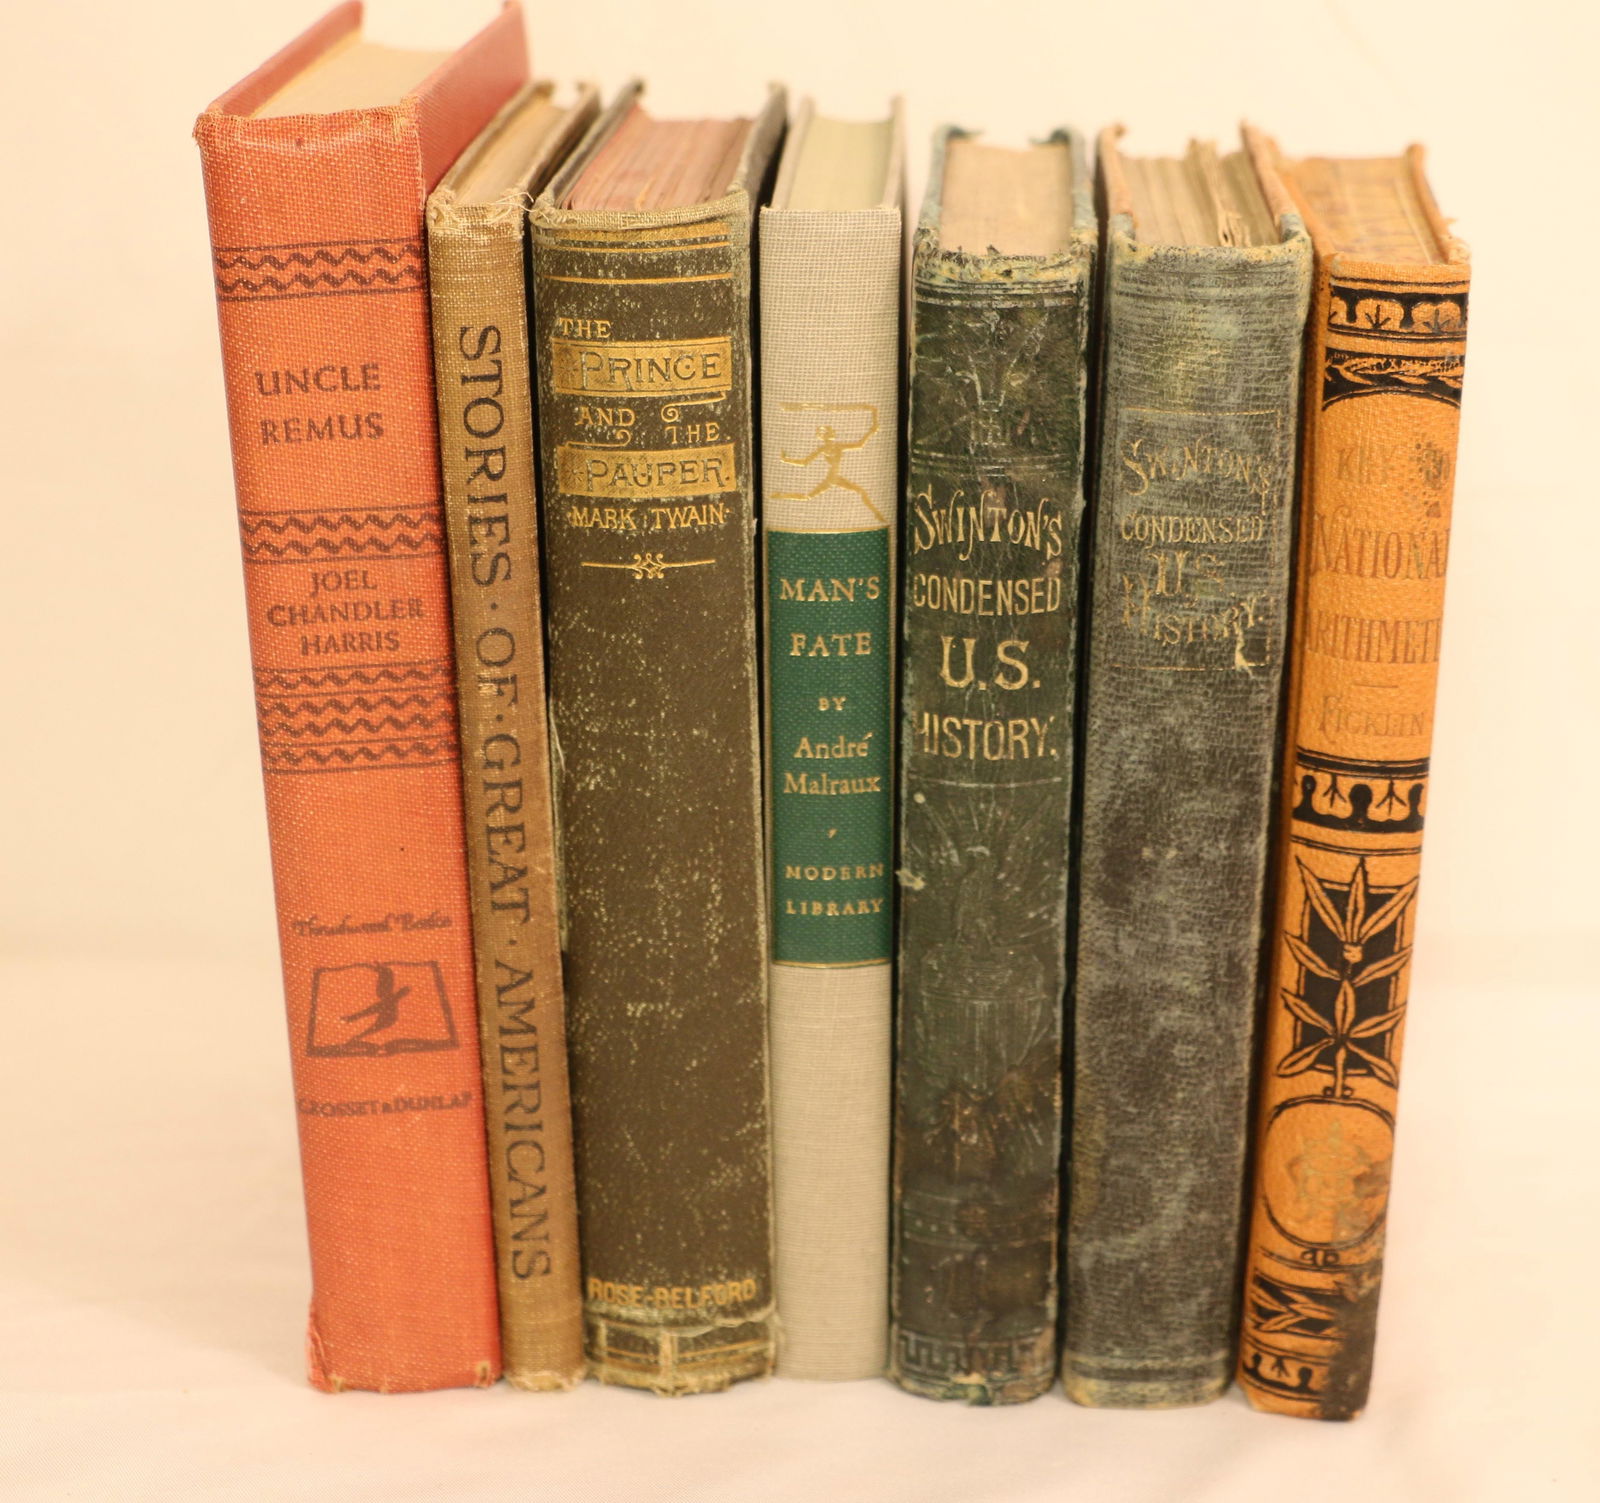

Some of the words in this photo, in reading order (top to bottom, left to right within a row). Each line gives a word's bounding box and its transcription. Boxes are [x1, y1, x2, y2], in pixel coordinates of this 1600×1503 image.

[559, 318, 611, 338] THE
[255, 363, 382, 397] UNCLE
[579, 351, 722, 391] PRINCE
[260, 412, 384, 446] REMUS
[575, 406, 636, 427] AND
[460, 325, 511, 588] STORIES
[572, 506, 637, 530] MARK
[651, 503, 725, 529] TWAIN
[914, 484, 1062, 561] SWINTON'S
[1121, 510, 1264, 550] CONDENSED
[310, 570, 377, 598] JOEL
[780, 576, 881, 602] MAN'S
[913, 573, 1061, 616] CONDENSED
[267, 597, 424, 627] CHANDLER
[301, 631, 401, 657] HARRIS
[790, 632, 872, 657] FATE
[476, 627, 518, 706] OF
[940, 635, 1041, 690] U.S.
[819, 697, 846, 711] BY
[793, 732, 873, 759] André
[783, 771, 881, 795] Malraux
[483, 733, 530, 923] GREAT
[785, 863, 884, 881] MODERN
[785, 898, 884, 917] LIBRARY
[495, 959, 551, 1281] AMERICANS
[588, 1277, 757, 1310] ROSE-BELFORD
